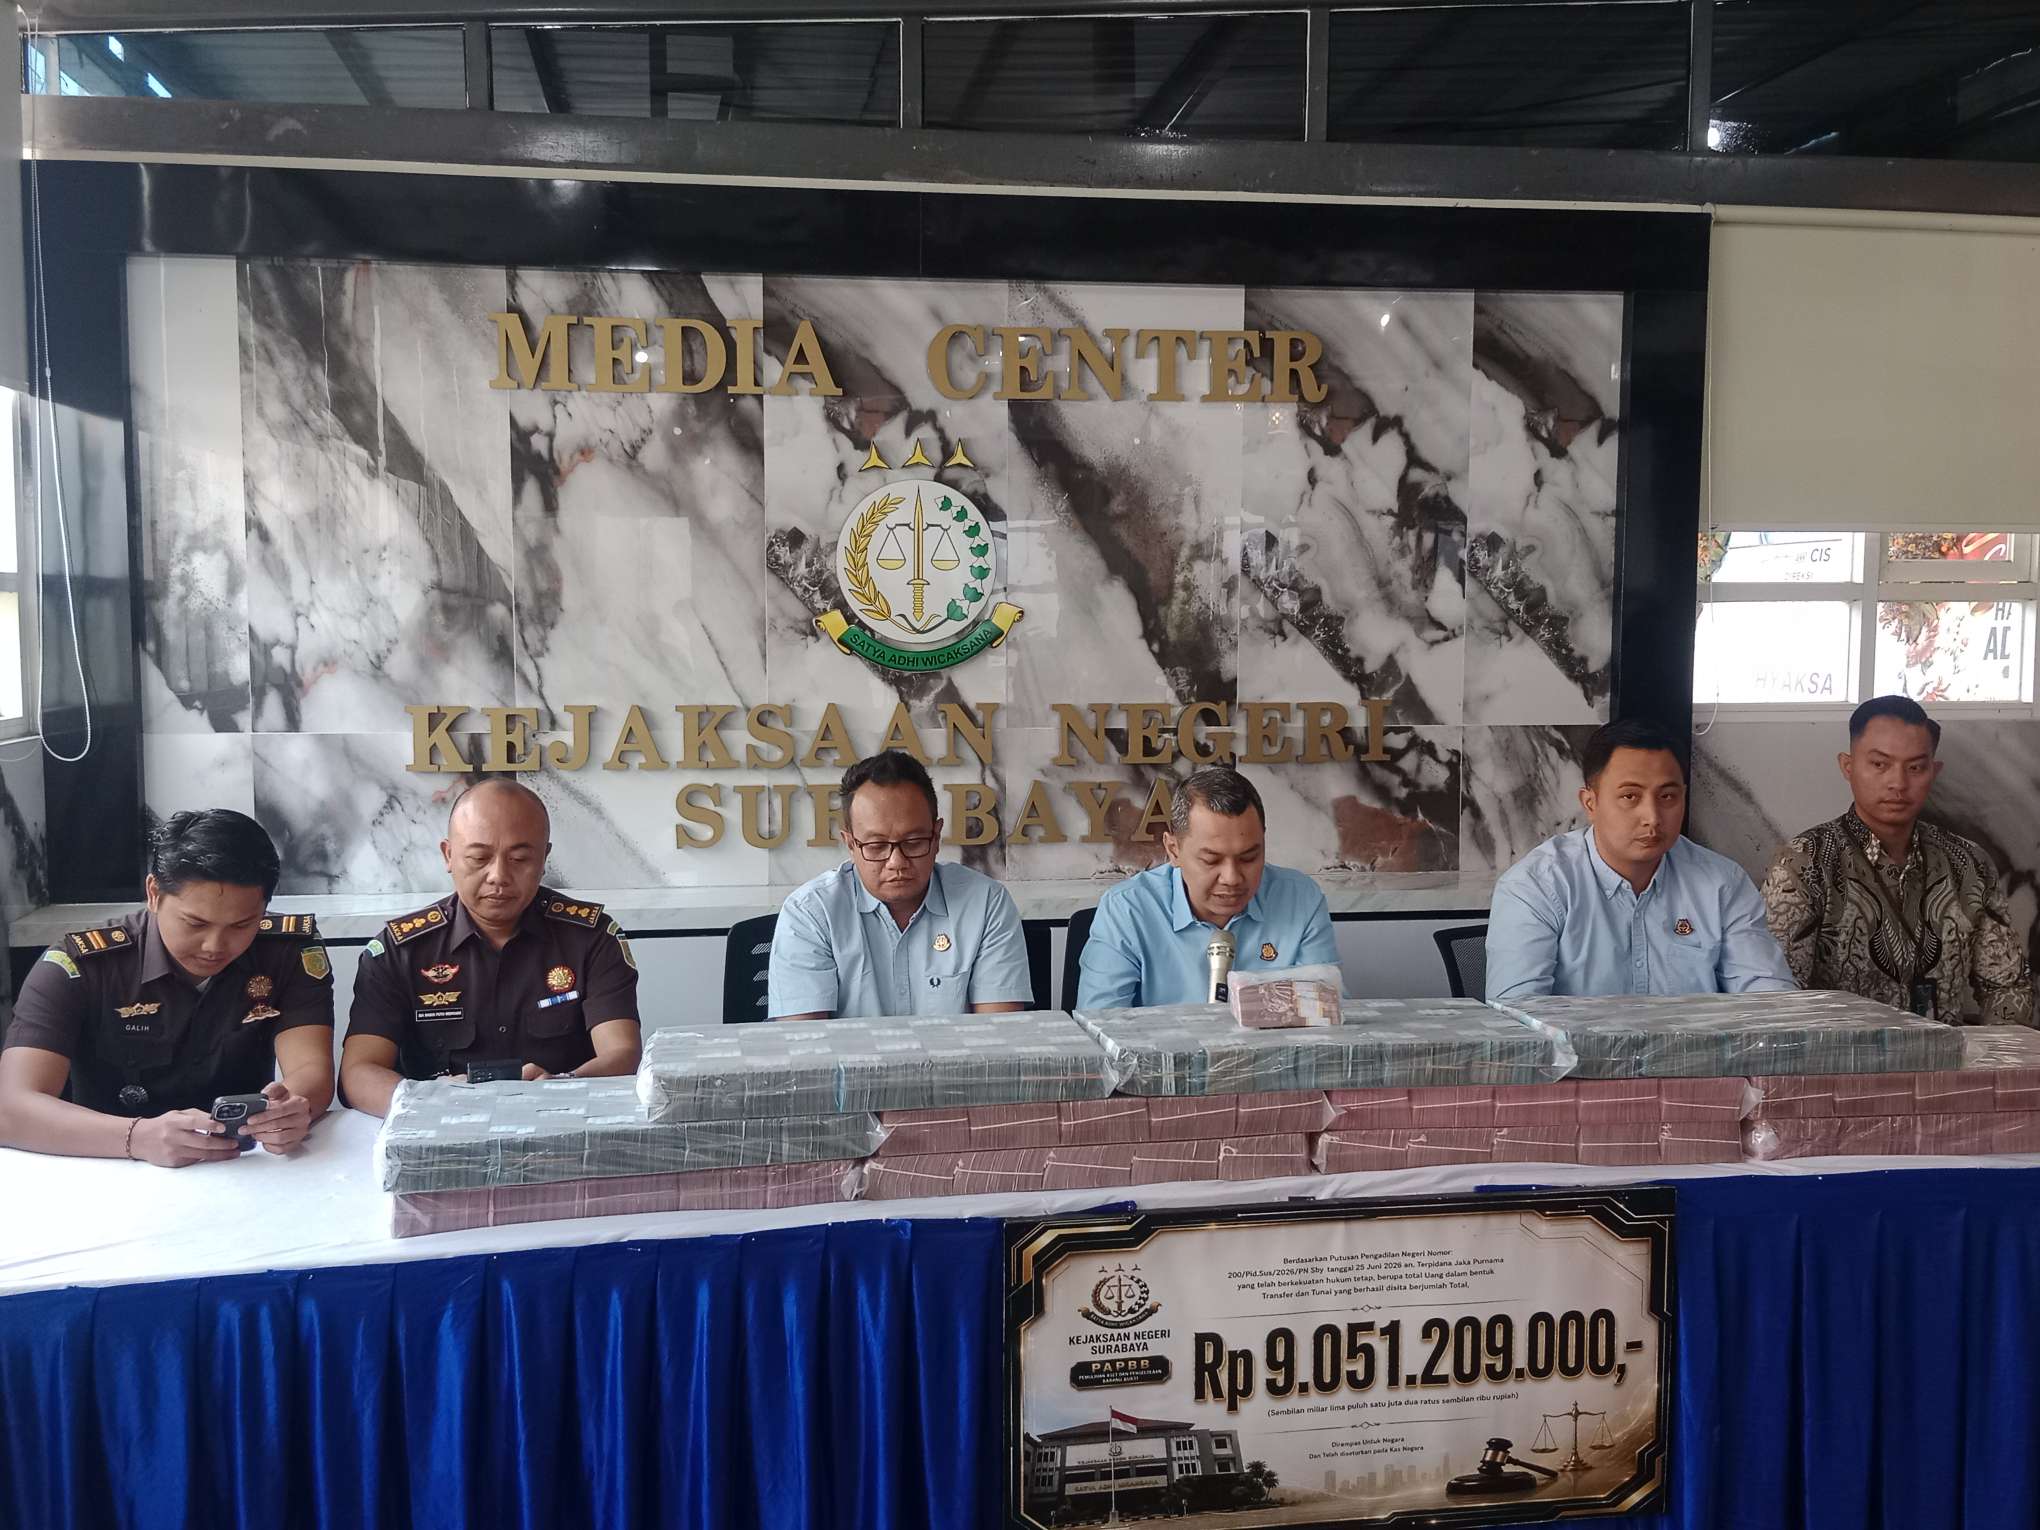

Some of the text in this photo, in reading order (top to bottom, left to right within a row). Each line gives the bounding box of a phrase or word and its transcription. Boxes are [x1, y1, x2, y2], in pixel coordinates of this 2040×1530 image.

[488, 312, 1328, 403] MEDIA CENTER
[1810, 547, 1831, 562] CIS
[850, 627, 993, 667] SATYA ADHI WICAKSANA
[405, 699, 1393, 773] KEJAKSAAN NEGERI
[125, 1024, 150, 1032] GALIH
[1283, 1256, 1327, 1264] Berdasarkan
[1361, 1252, 1399, 1261] Pengadilan
[1401, 1251, 1425, 1259] Negeri
[1311, 1266, 1324, 1275] Sby
[1327, 1264, 1354, 1273] tanggal
[1417, 1261, 1452, 1269] Terpidana
[1237, 1282, 1255, 1291] yang
[1278, 1278, 1324, 1287] berkekuatan
[1377, 1273, 1403, 1282] berupa
[1425, 1272, 1444, 1280] Uang
[1445, 1270, 1467, 1278] dalam
[1262, 1292, 1293, 1300] Transfer
[1334, 1288, 1352, 1296] yang
[1354, 1285, 1384, 1293] berhasil
[1409, 1283, 1447, 1291] berjumlah
[1069, 1329, 1171, 1346] KEJAKSAAN NEGERI
[1091, 1342, 1149, 1355] SURABAYA
[1092, 1359, 1150, 1373] PAPBB
[1193, 1308, 1643, 1414] Rp 9.051.209.000,-
[1268, 1408, 1305, 1417] (Sembilan
[1347, 1402, 1368, 1410] puluh
[1387, 1400, 1402, 1408] juta
[1442, 1396, 1475, 1404] sembilan
[1493, 1391, 1519, 1401] rupiah)
